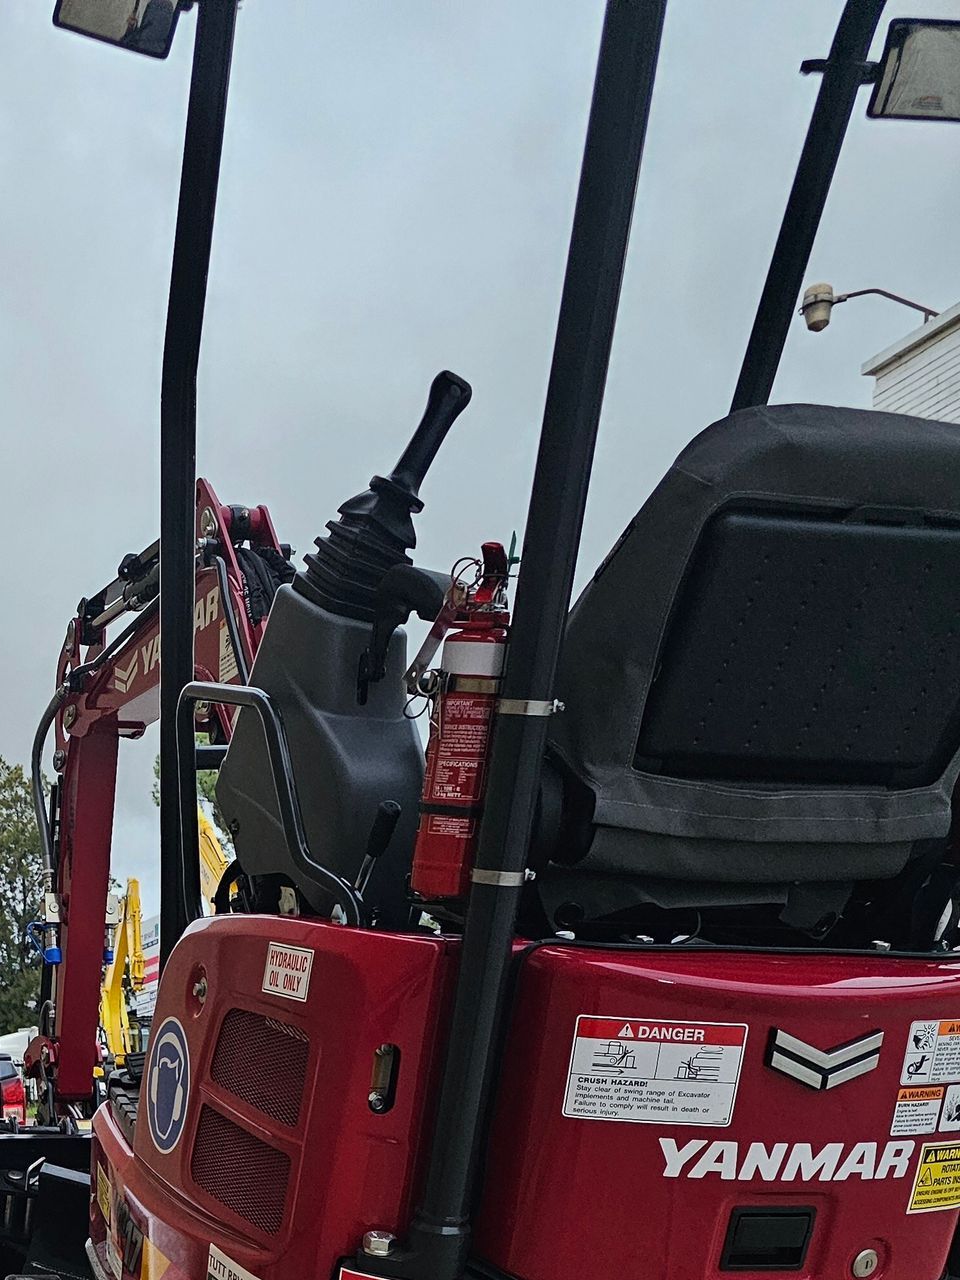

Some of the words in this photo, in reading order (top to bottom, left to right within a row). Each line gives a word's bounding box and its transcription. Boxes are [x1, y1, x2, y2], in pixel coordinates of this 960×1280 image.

[142, 586, 219, 675] YAAR
[437, 760, 478, 768] SPECIFICATIONS
[270, 950, 307, 972] HYDRAULIC
[269, 970, 279, 987] OIL
[283, 973, 302, 992] ONLY
[638, 1026, 705, 1041] DANGER
[578, 1076, 607, 1085] CRUSH
[611, 1079, 648, 1088] HAZARD!
[575, 1092, 613, 1100] implements
[576, 1084, 591, 1092] Stay
[624, 1088, 643, 1096] swing
[908, 1089, 941, 1099] WARNING
[609, 1102, 633, 1110] comply
[659, 1137, 916, 1182] YANMAR
[936, 1148, 960, 1161] WARN
[941, 1163, 960, 1174] ROTAT
[933, 1176, 951, 1187] PARTS
[952, 1176, 960, 1184] INS
[209, 1254, 227, 1278] TUTT
